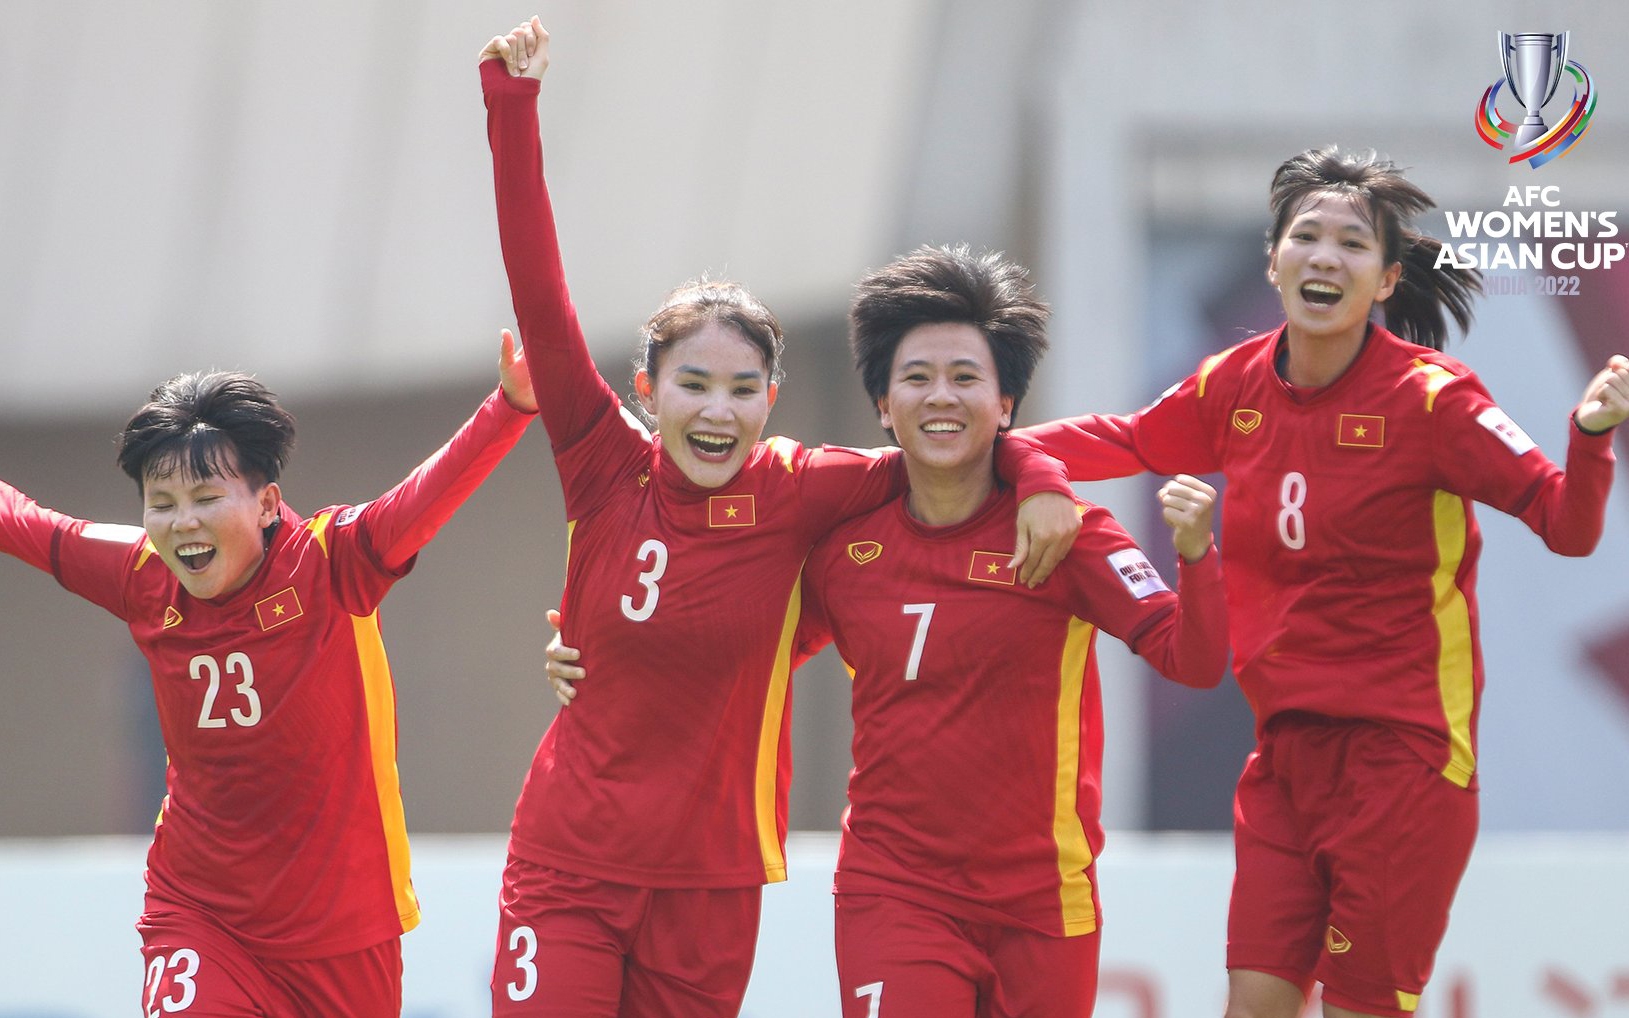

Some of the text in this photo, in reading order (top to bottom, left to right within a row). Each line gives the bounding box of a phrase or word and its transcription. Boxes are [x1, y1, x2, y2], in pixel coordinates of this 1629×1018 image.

[1278, 471, 1307, 550] 8
[620, 538, 669, 623] 3
[902, 603, 936, 681] 7
[188, 651, 262, 729] 23
[145, 947, 201, 1018] 23
[507, 925, 539, 1002] 3
